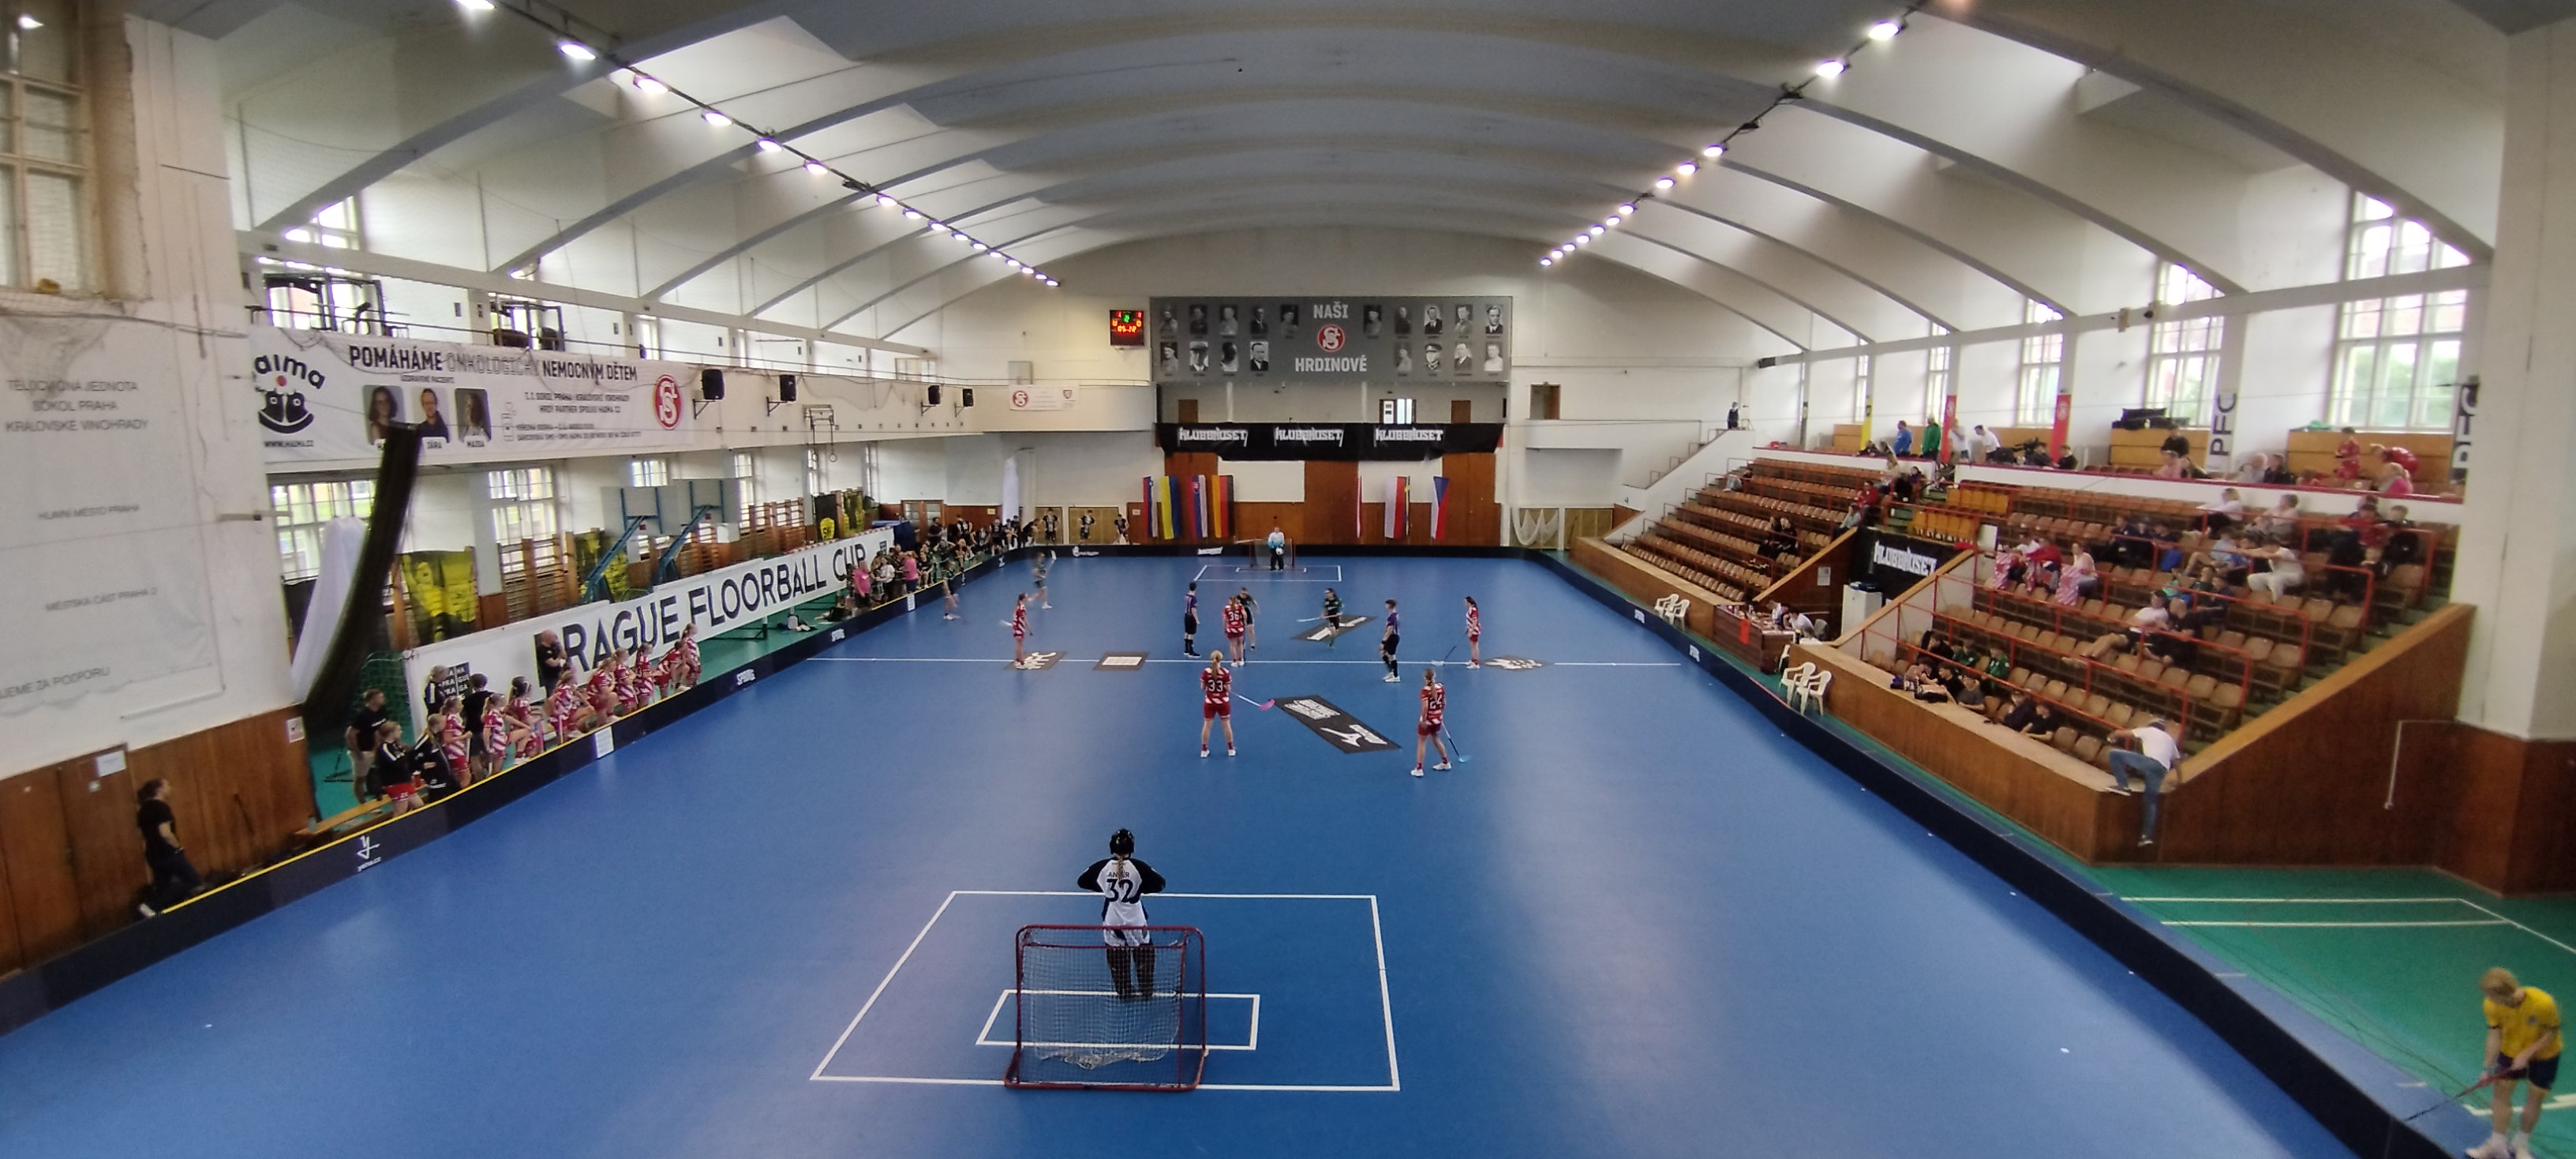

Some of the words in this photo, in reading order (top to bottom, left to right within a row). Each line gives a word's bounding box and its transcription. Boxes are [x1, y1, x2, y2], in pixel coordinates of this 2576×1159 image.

[1313, 301, 1349, 319] NAŠI
[349, 344, 443, 371] POMÁHÁME
[606, 361, 638, 381] DĚTEM
[1295, 354, 1367, 372] HRDINOVÉ
[2210, 392, 2236, 456] PFC
[688, 554, 827, 627] FLOORBALL
[1228, 611, 1240, 621] 36
[1208, 679, 1224, 692] 33
[1105, 878, 1135, 903] 32
